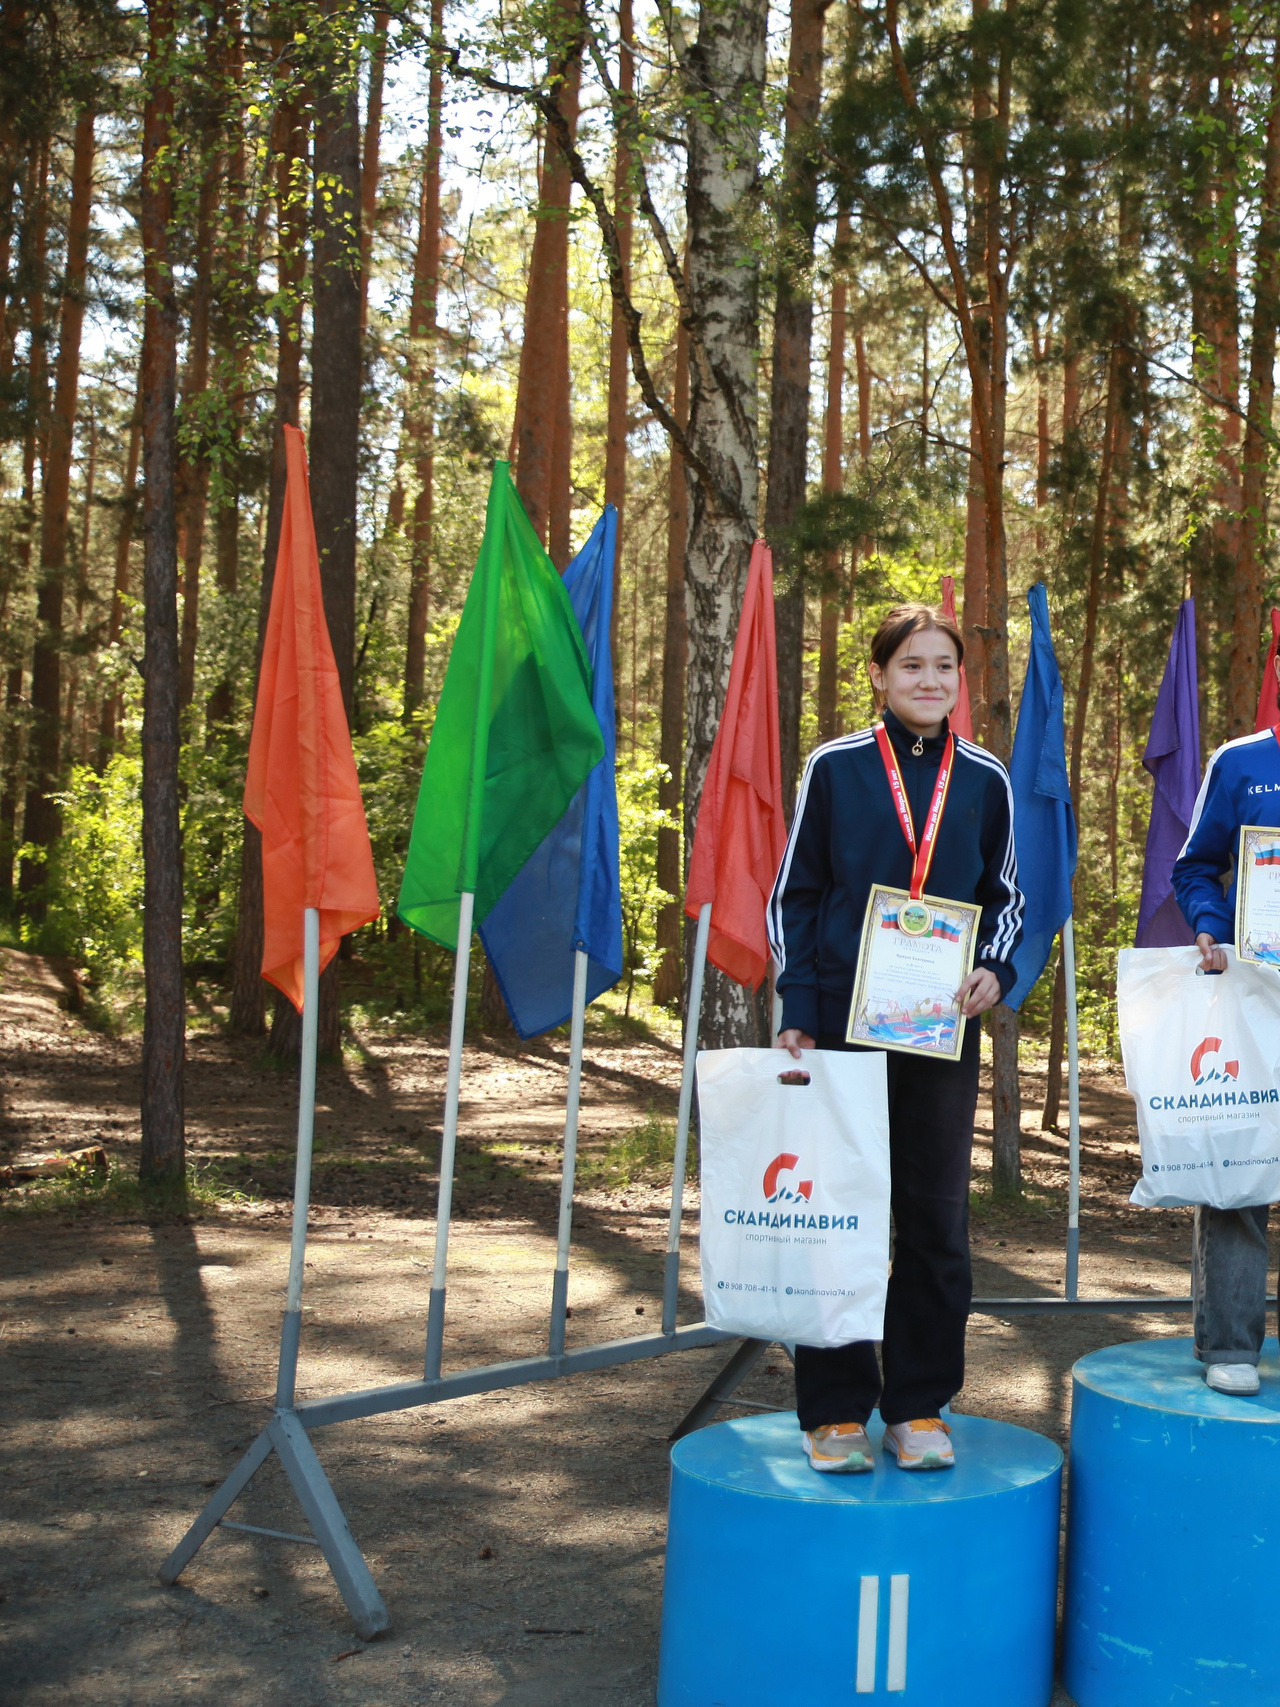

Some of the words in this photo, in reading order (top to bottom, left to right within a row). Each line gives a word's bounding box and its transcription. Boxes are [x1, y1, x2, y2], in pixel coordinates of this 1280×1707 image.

[897, 791, 907, 813] Марья
[925, 823, 934, 841] Иван
[932, 791, 942, 814] Марья
[894, 937, 942, 953] ГРАМОТА
[1149, 1088, 1280, 1110] СКАНДИНАВИЯ
[1177, 1112, 1225, 1124] спортивный
[1226, 1111, 1260, 1120] магазин
[1166, 1163, 1181, 1172] 908
[723, 1209, 859, 1230] СКАНДИНАВИЯ
[745, 1233, 791, 1244] спортивный
[793, 1236, 827, 1245] магазин
[744, 1283, 778, 1293] 708-41-14
[793, 1288, 856, 1297] skandinavia74.ru
[857, 1574, 909, 1693] II
